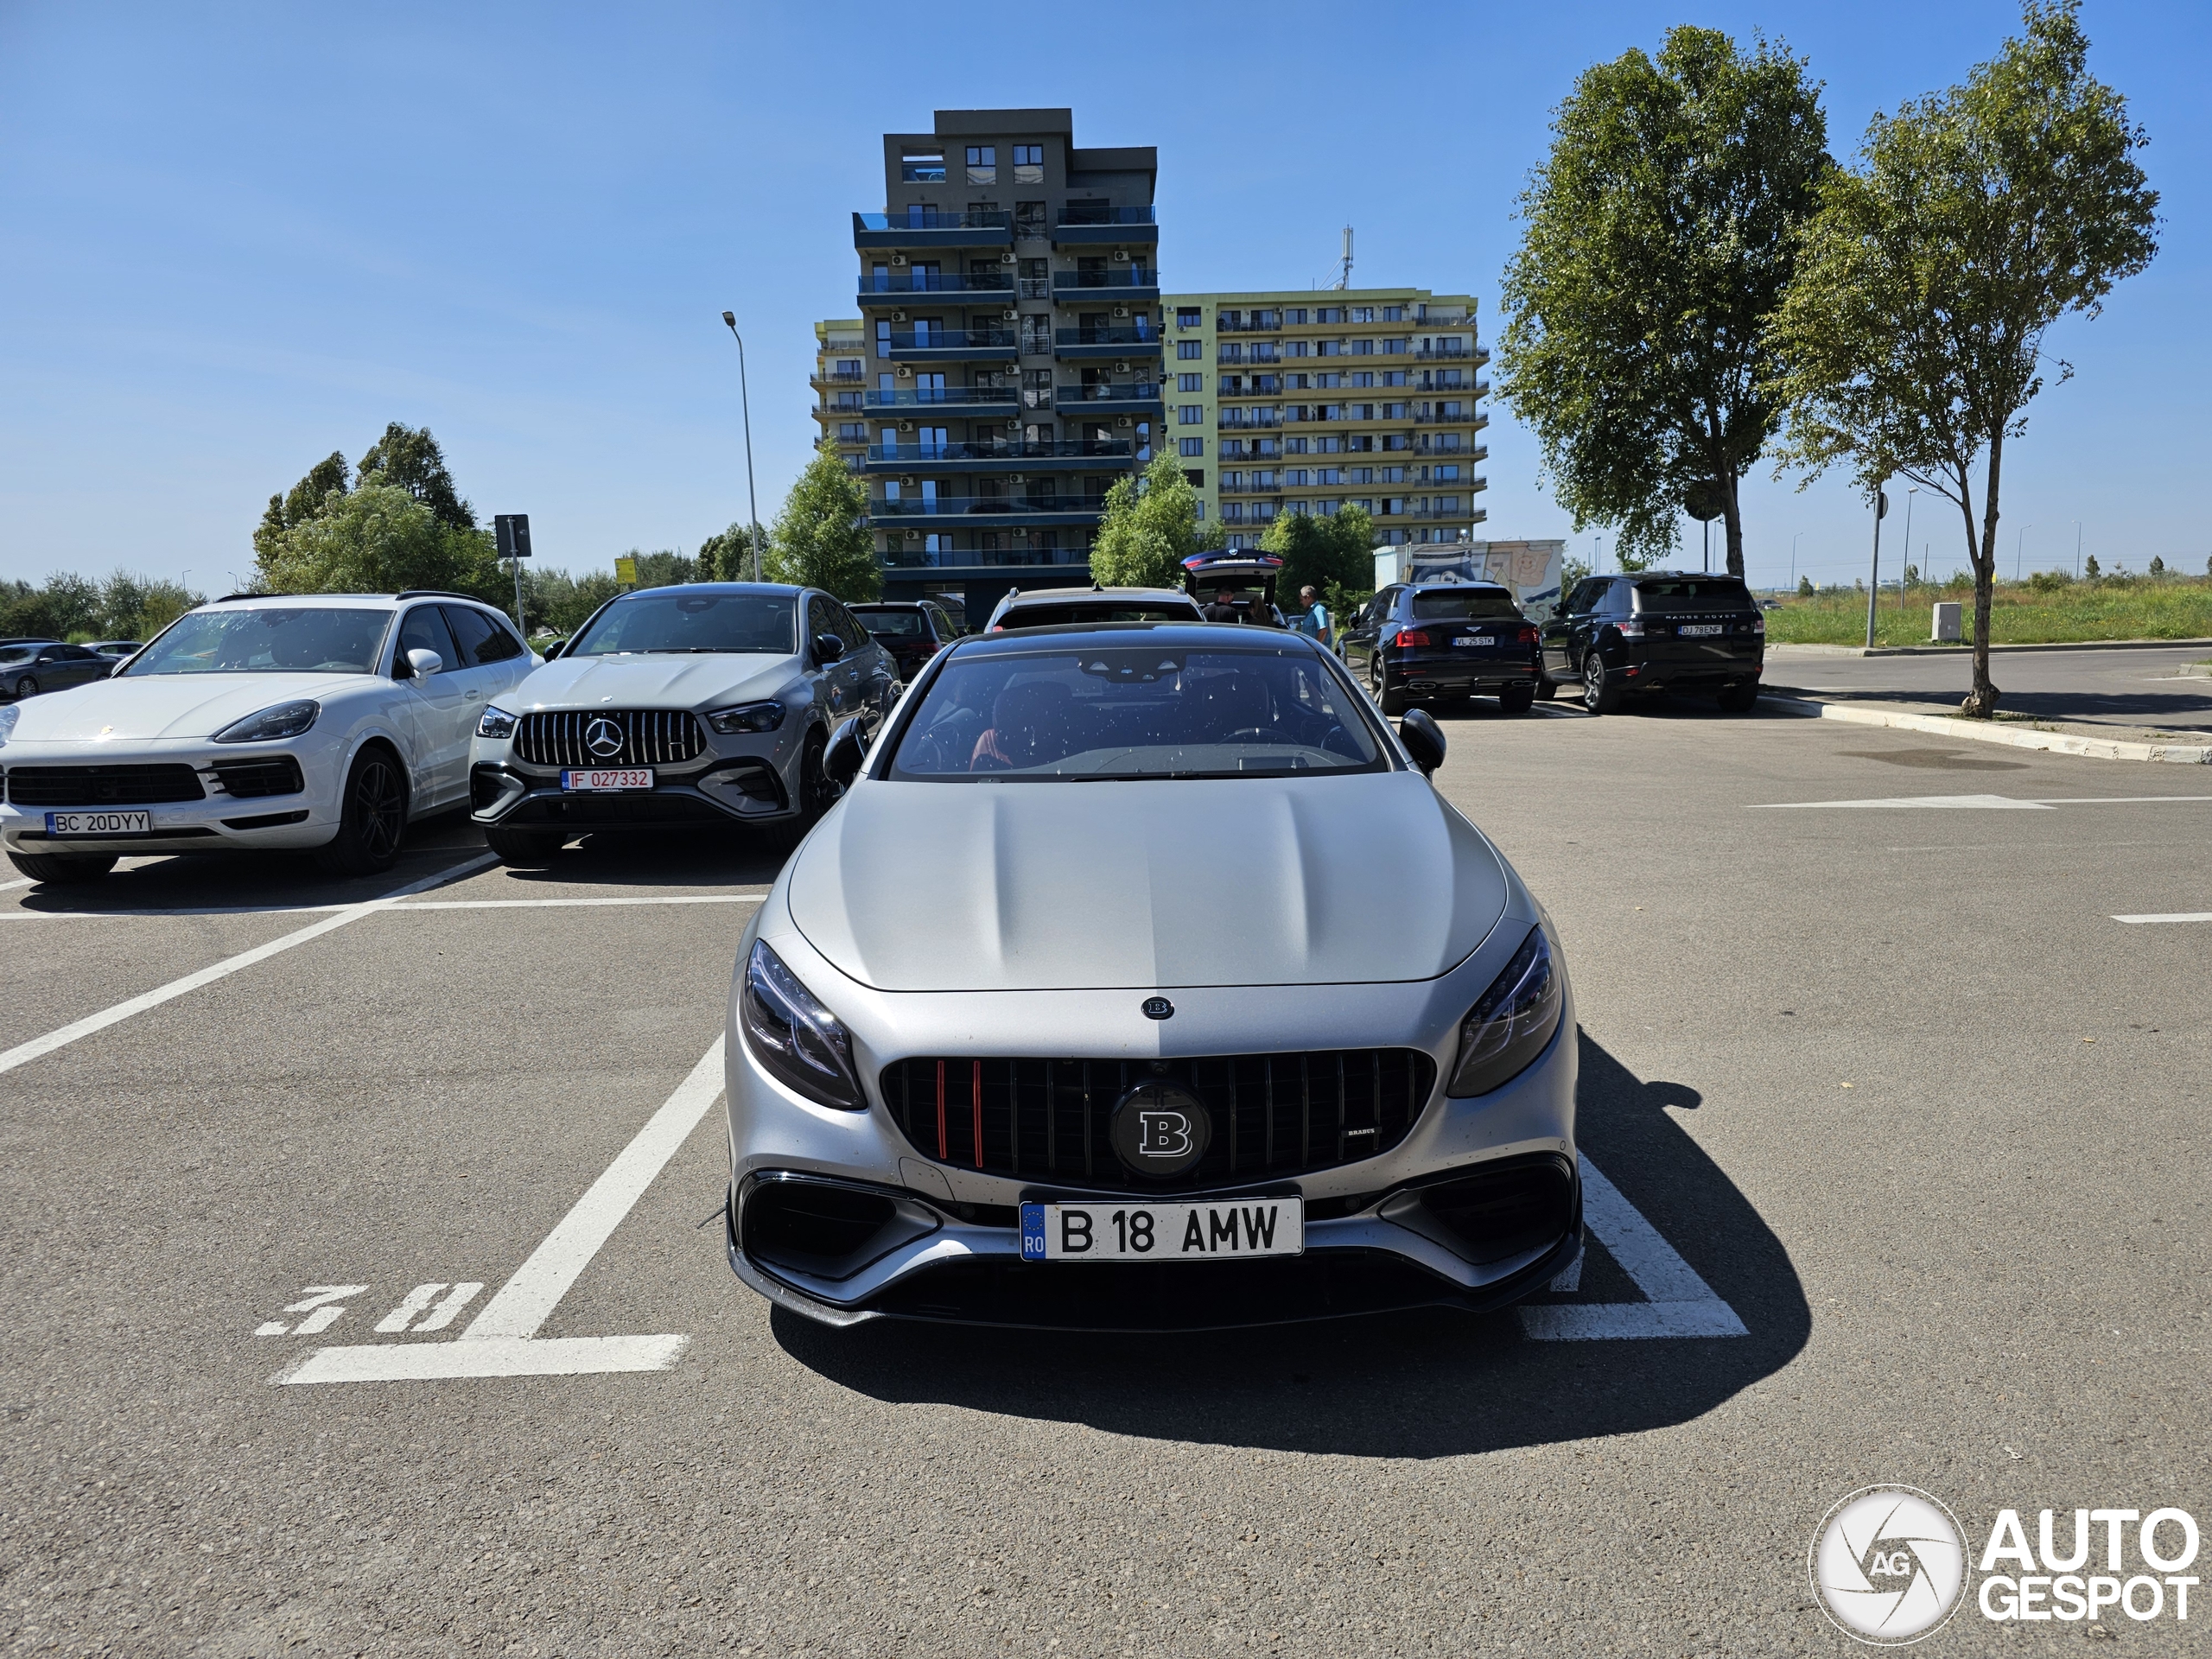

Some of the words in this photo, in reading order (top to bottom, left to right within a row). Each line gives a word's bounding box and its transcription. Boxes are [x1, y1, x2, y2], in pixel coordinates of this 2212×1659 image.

[570, 772, 585, 787] IF
[591, 771, 648, 787] 027332
[55, 816, 79, 832] BC
[86, 814, 145, 831] 20DYY
[1148, 1001, 1167, 1014] B
[1139, 1111, 1193, 1158] B
[1348, 1128, 1375, 1136] BRABUS
[1062, 1210, 1093, 1253] B
[1112, 1210, 1154, 1253] 18
[1181, 1205, 1278, 1252] AMW
[1025, 1236, 1044, 1253] RO
